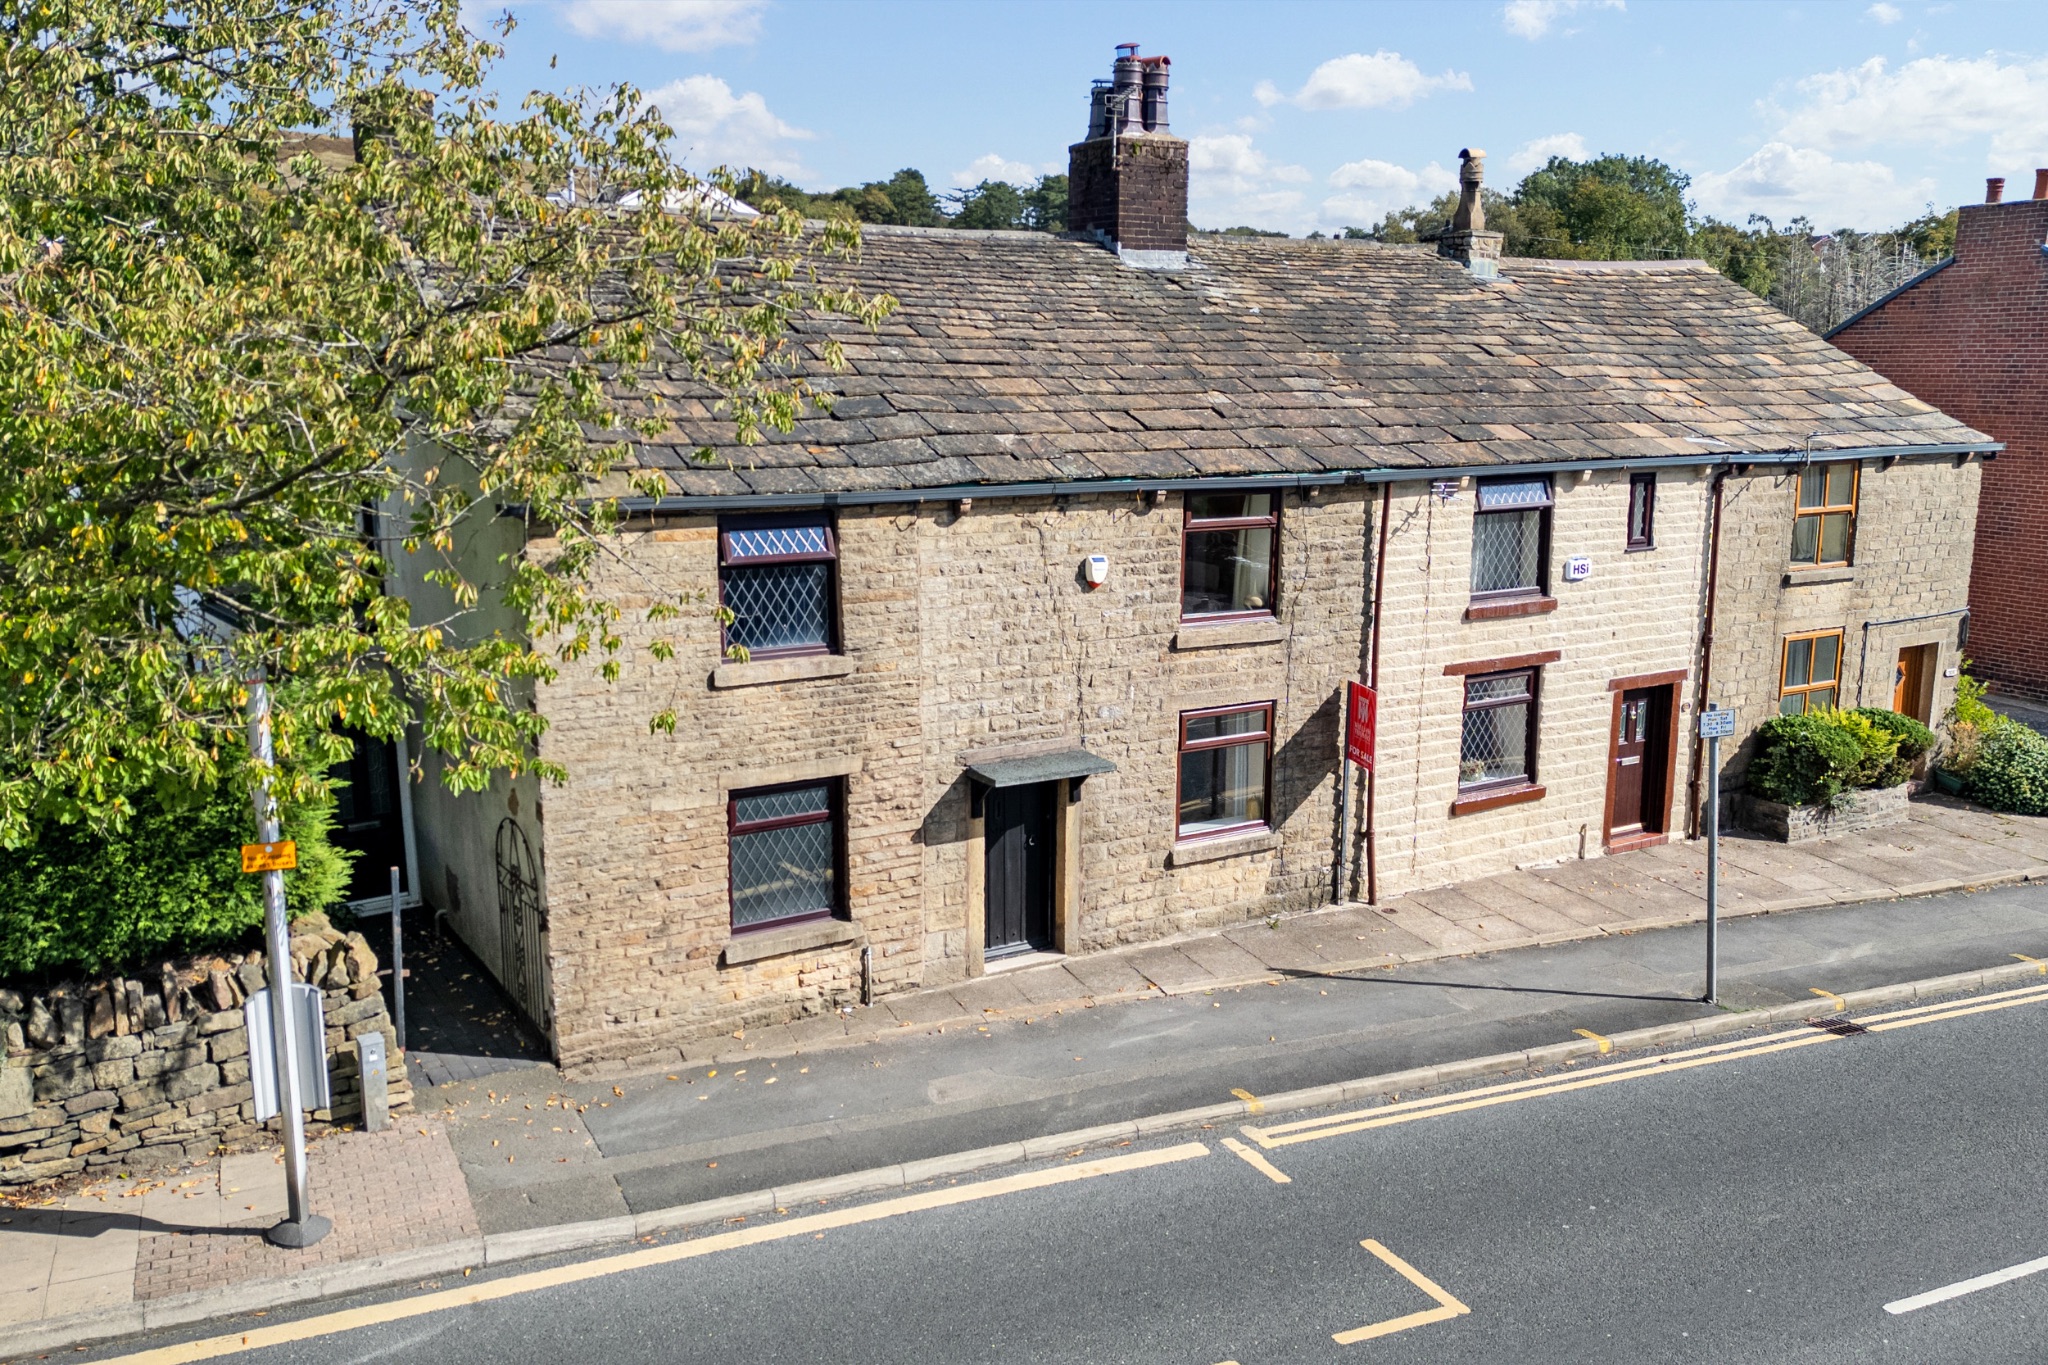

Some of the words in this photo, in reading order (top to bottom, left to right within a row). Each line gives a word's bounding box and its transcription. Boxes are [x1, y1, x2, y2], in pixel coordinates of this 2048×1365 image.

[1573, 563, 1589, 575] HSi
[1349, 744, 1360, 757] FOR
[1360, 750, 1373, 764] SALE
